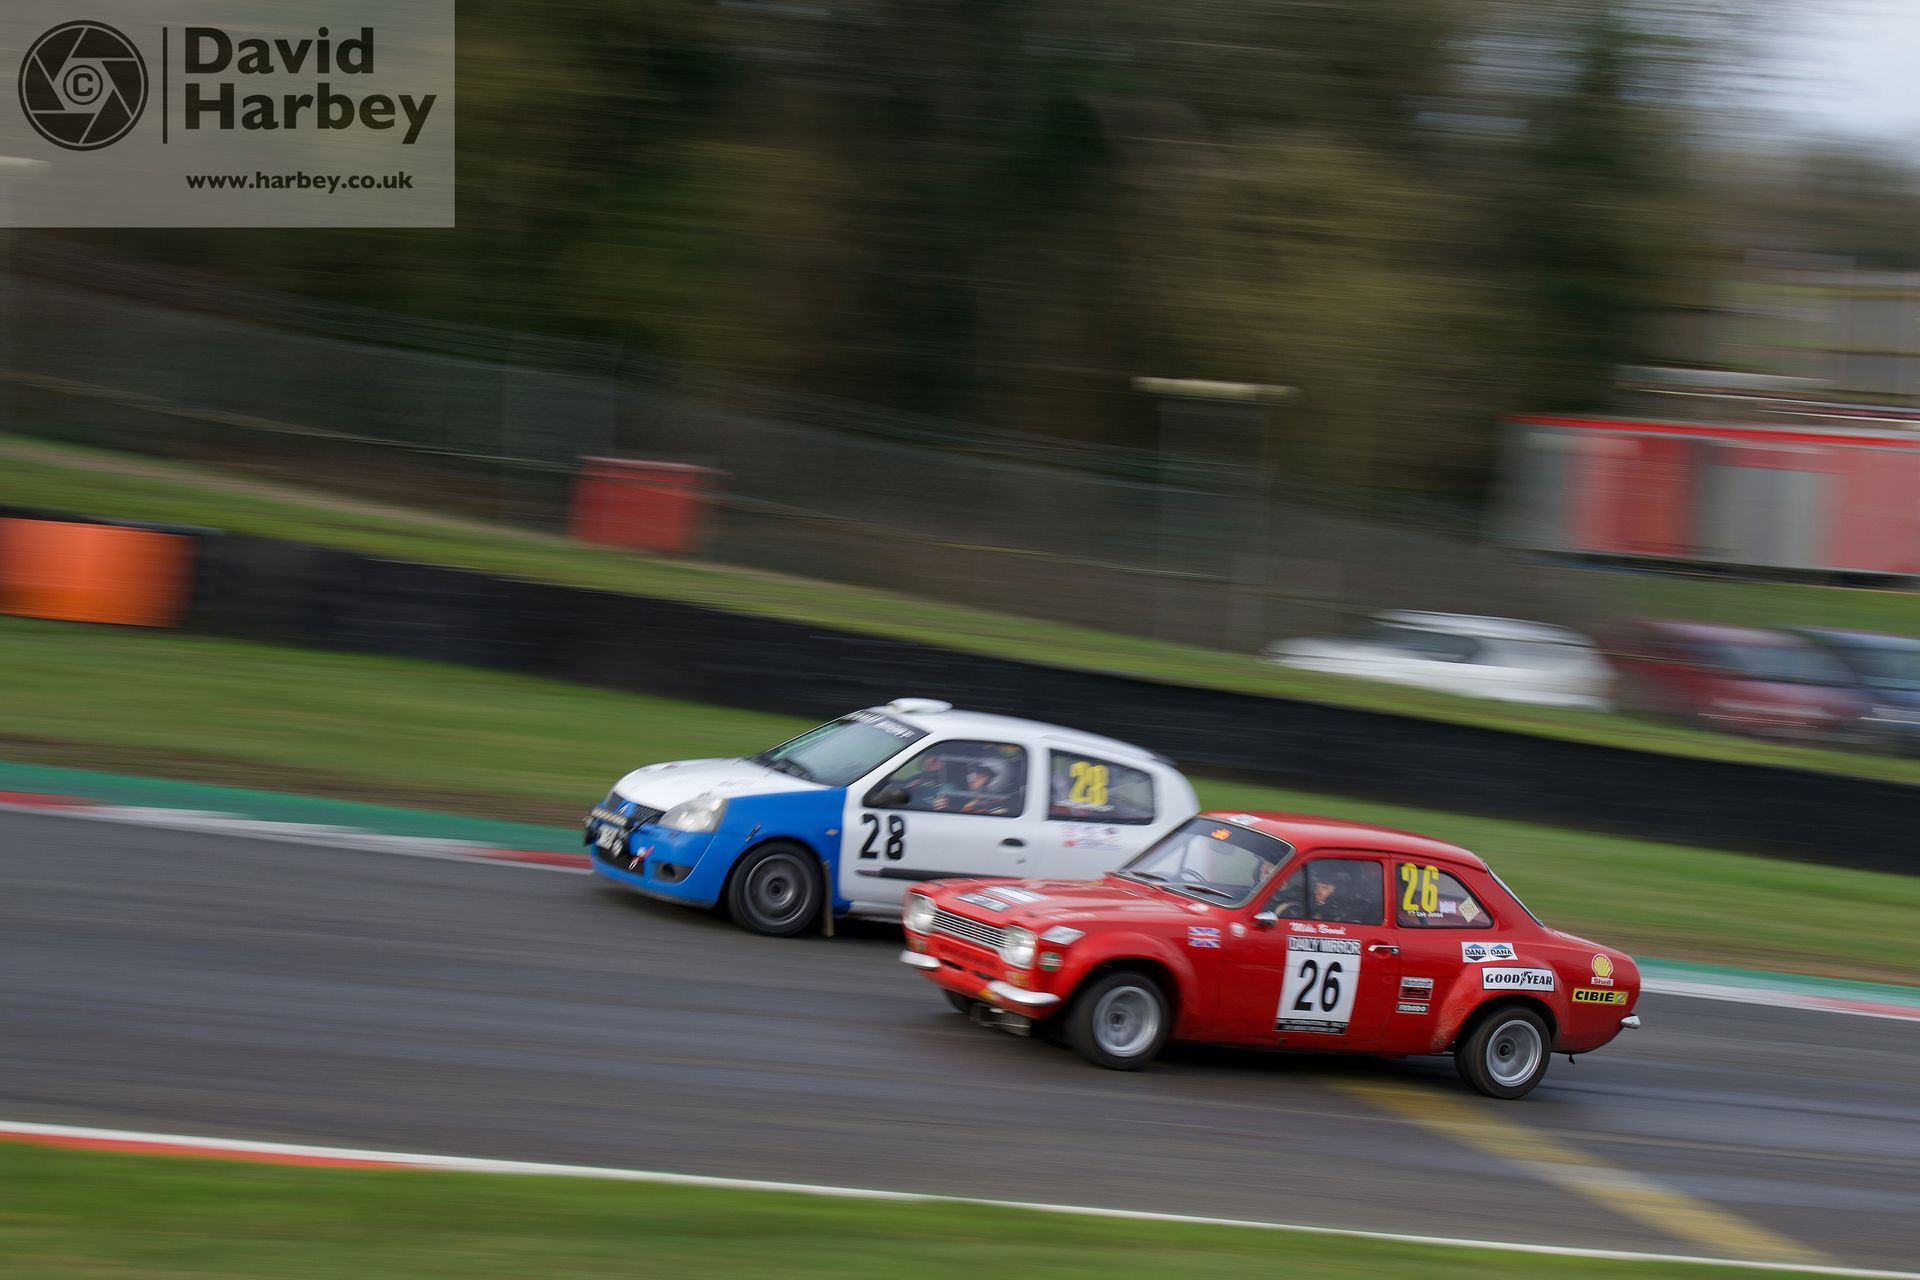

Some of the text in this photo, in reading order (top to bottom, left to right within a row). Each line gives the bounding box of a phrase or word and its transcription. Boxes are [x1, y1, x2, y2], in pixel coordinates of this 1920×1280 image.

[1069, 761, 1110, 806] 28
[858, 813, 906, 860] 28
[1401, 863, 1439, 912] 26
[1288, 936, 1319, 952] DAILY
[1465, 948, 1487, 956] DANA
[1490, 948, 1513, 956] DANA
[1293, 959, 1343, 1013] 26
[1593, 978, 1612, 986] Shell
